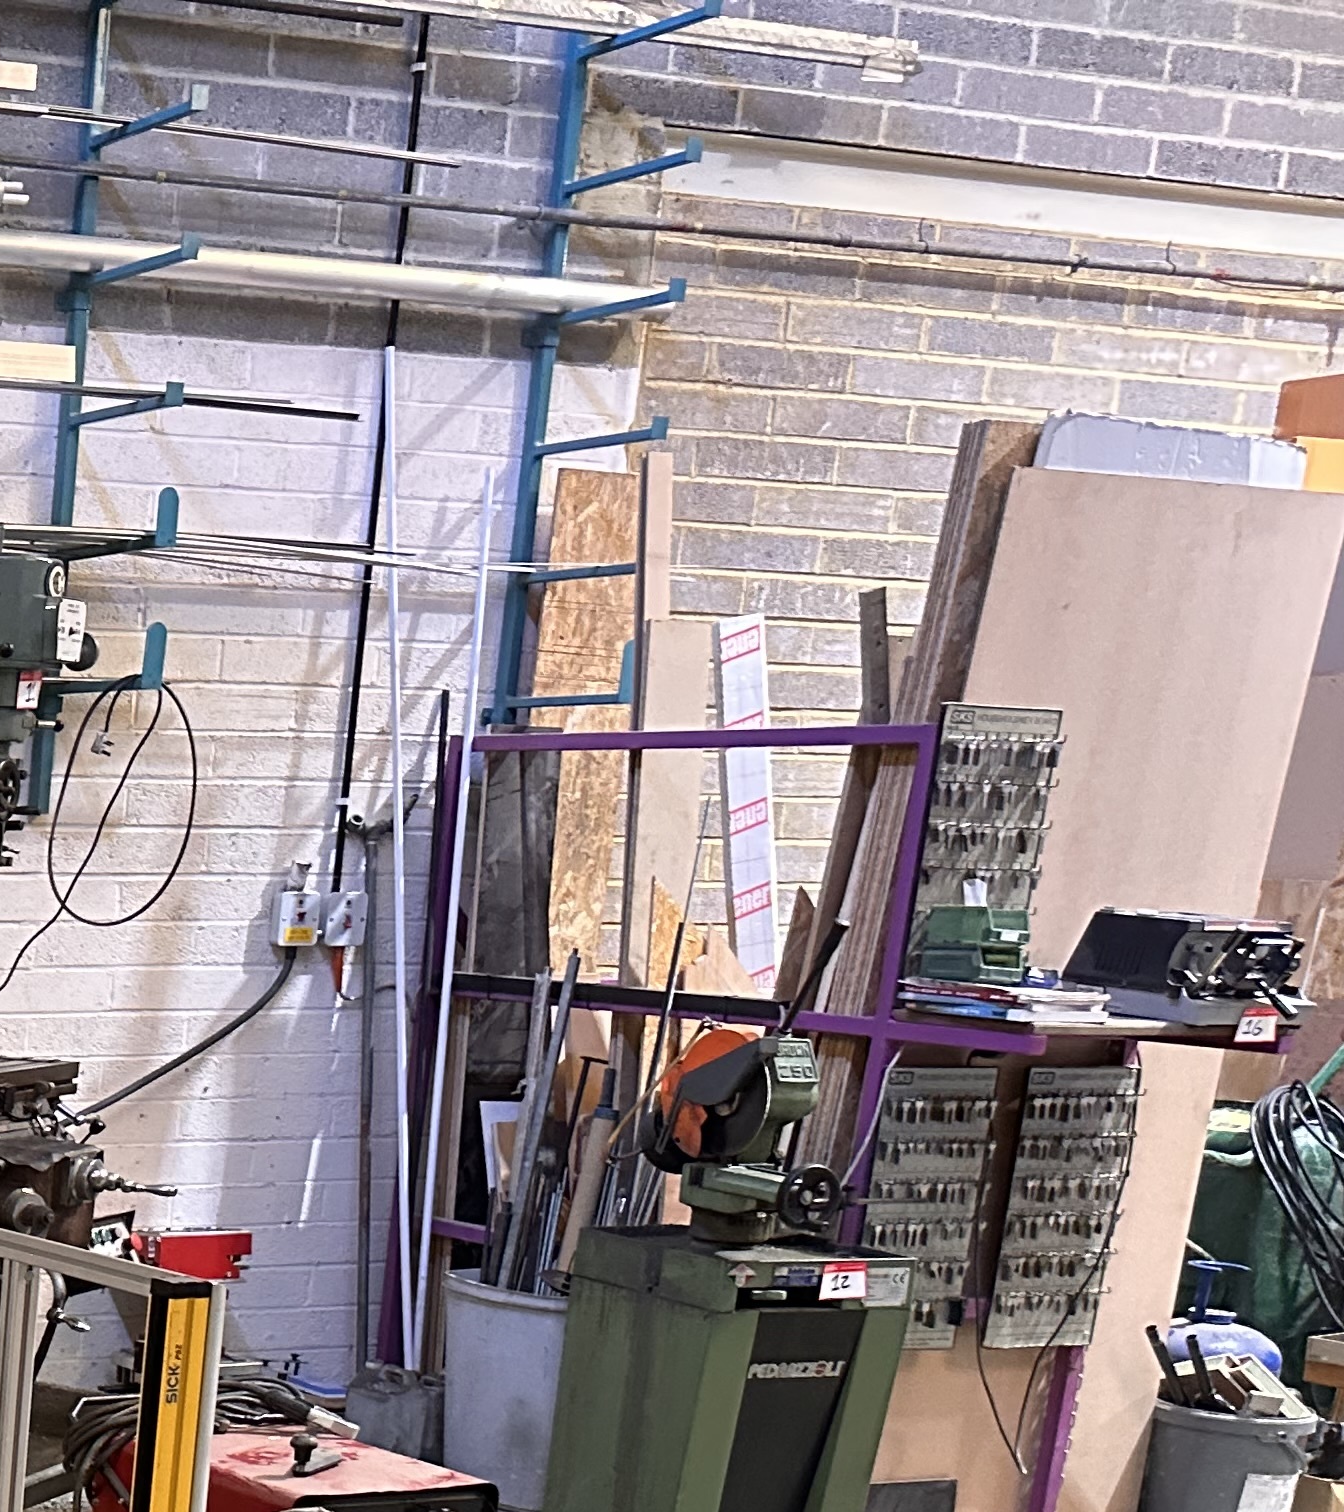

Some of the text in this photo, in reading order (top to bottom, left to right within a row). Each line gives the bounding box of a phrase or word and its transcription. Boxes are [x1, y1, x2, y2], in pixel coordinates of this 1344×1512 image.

[1242, 1019, 1263, 1037] 16
[830, 1274, 851, 1291] 12
[165, 1365, 181, 1404] SICK
